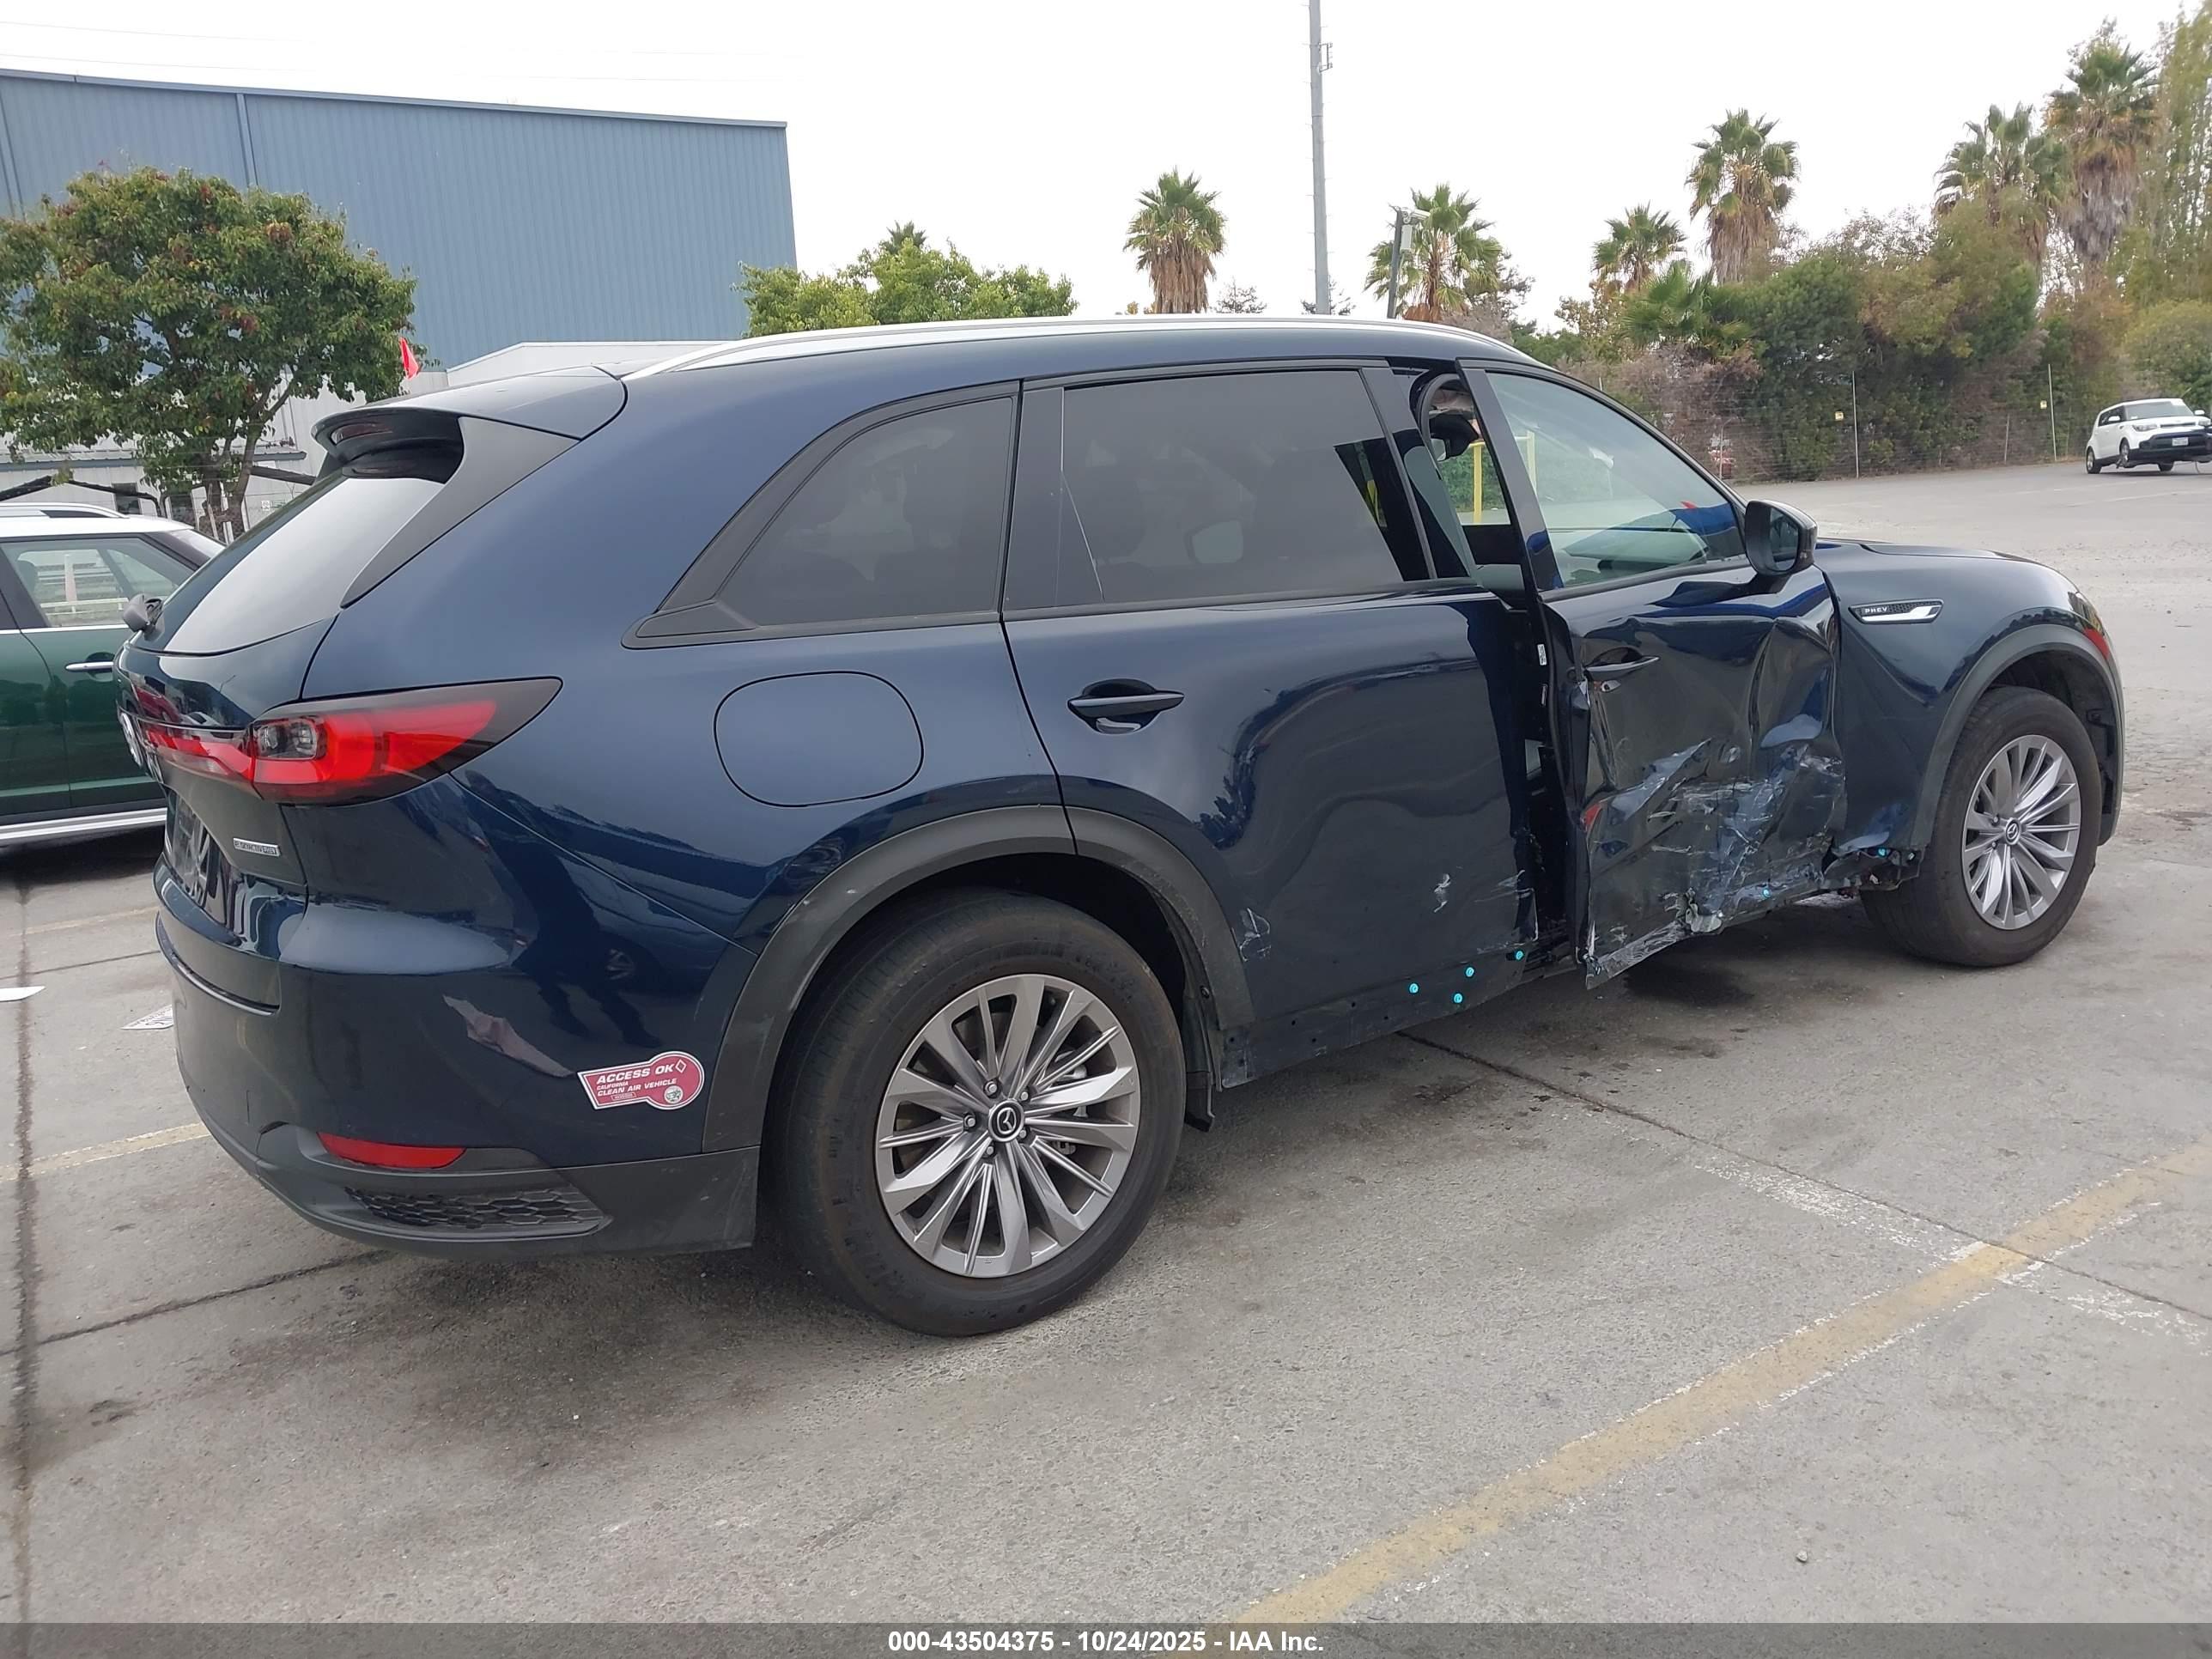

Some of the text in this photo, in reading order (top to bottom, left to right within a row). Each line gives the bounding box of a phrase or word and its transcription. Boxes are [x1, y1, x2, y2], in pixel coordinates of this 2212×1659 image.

[596, 1063, 674, 1085] ACCESS OK
[596, 1081, 629, 1091] CALIFORNIA
[597, 1086, 625, 1097] CLEAN
[628, 1085, 641, 1093] AIR
[644, 1078, 677, 1089] VEHICLE
